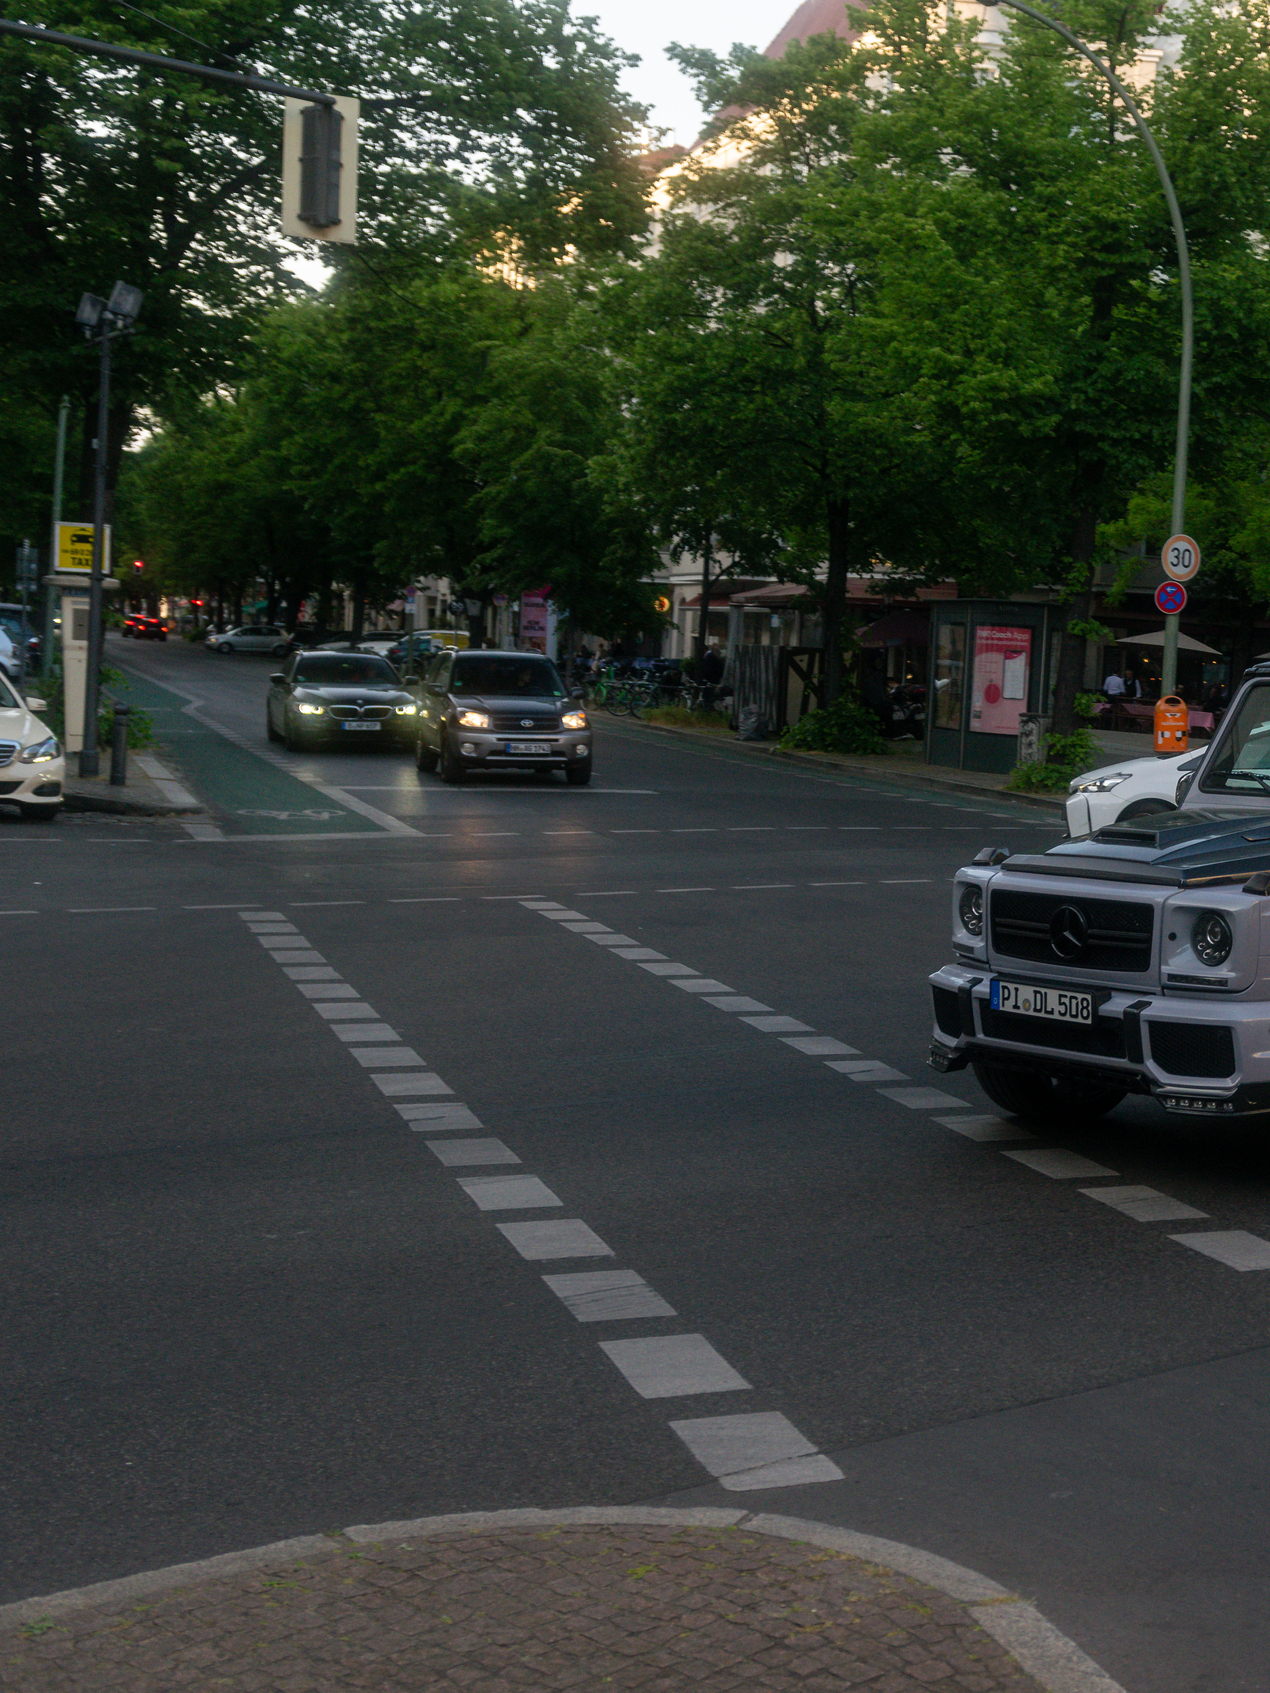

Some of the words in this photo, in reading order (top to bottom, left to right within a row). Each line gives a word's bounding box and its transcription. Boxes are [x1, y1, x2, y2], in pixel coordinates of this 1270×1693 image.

[1170, 547, 1191, 569] 30
[991, 631, 1012, 639] Coach
[1013, 632, 1029, 640] App
[1001, 985, 1020, 1010] PI
[1033, 990, 1054, 1015] DL
[1058, 994, 1090, 1020] 508
